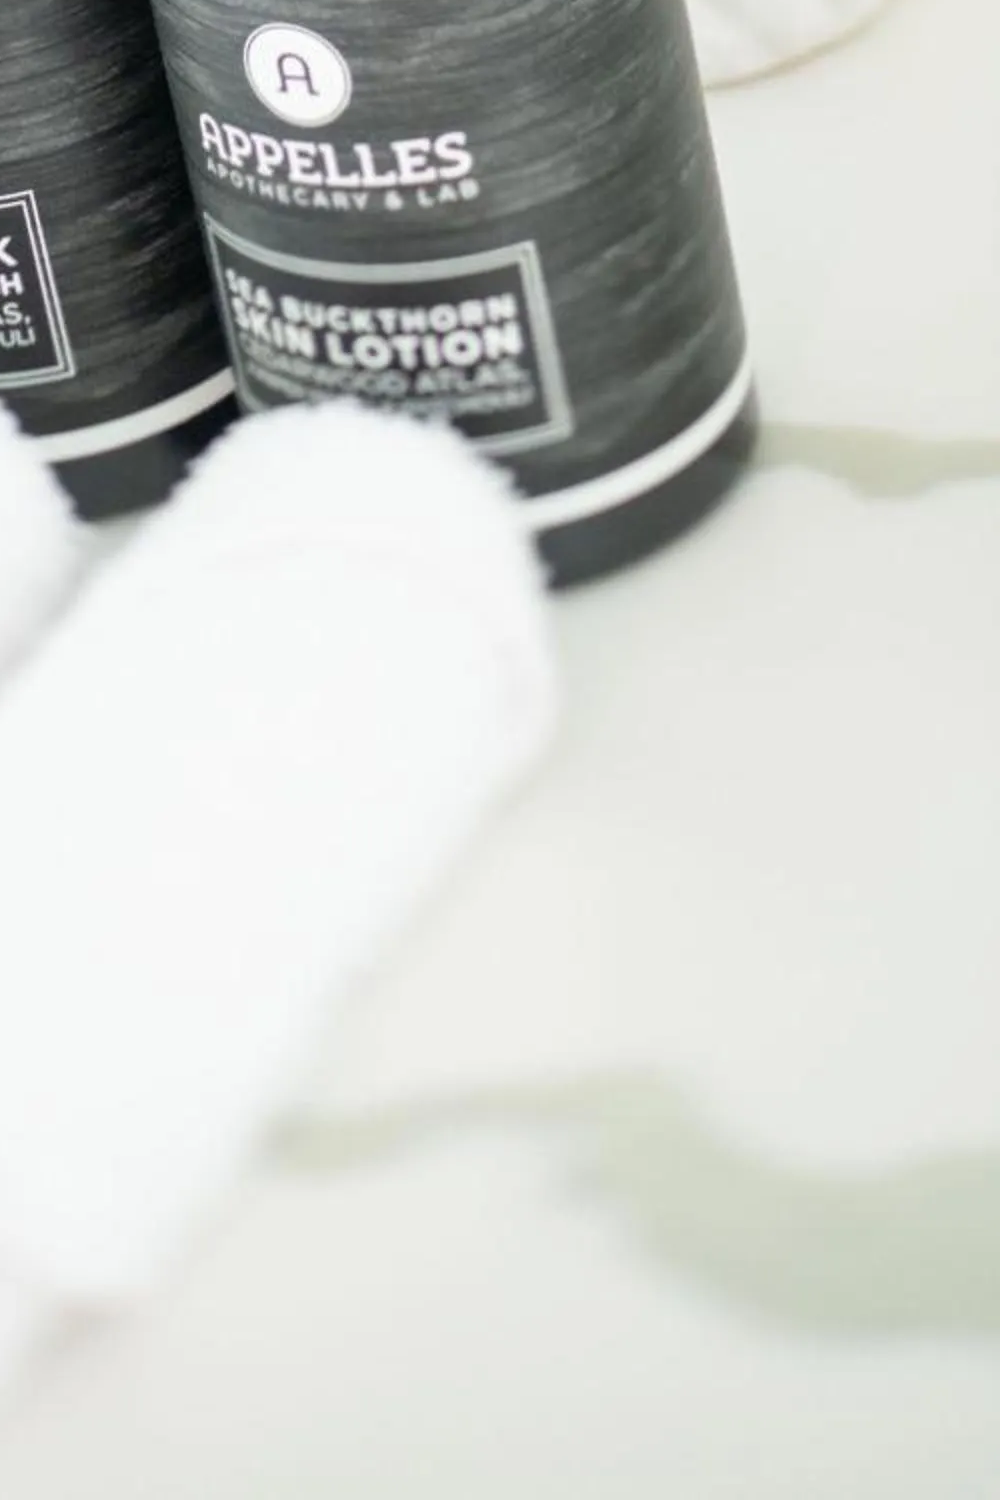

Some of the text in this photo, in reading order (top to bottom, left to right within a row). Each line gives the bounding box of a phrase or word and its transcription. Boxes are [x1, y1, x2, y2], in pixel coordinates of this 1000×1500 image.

[276, 51, 320, 97] A
[199, 112, 474, 189] APPELLES
[206, 156, 368, 211] APOTHECARY
[416, 177, 481, 208] LAB
[231, 296, 525, 371] SKIN LOTION
[279, 291, 518, 336] BUCKTHORN
